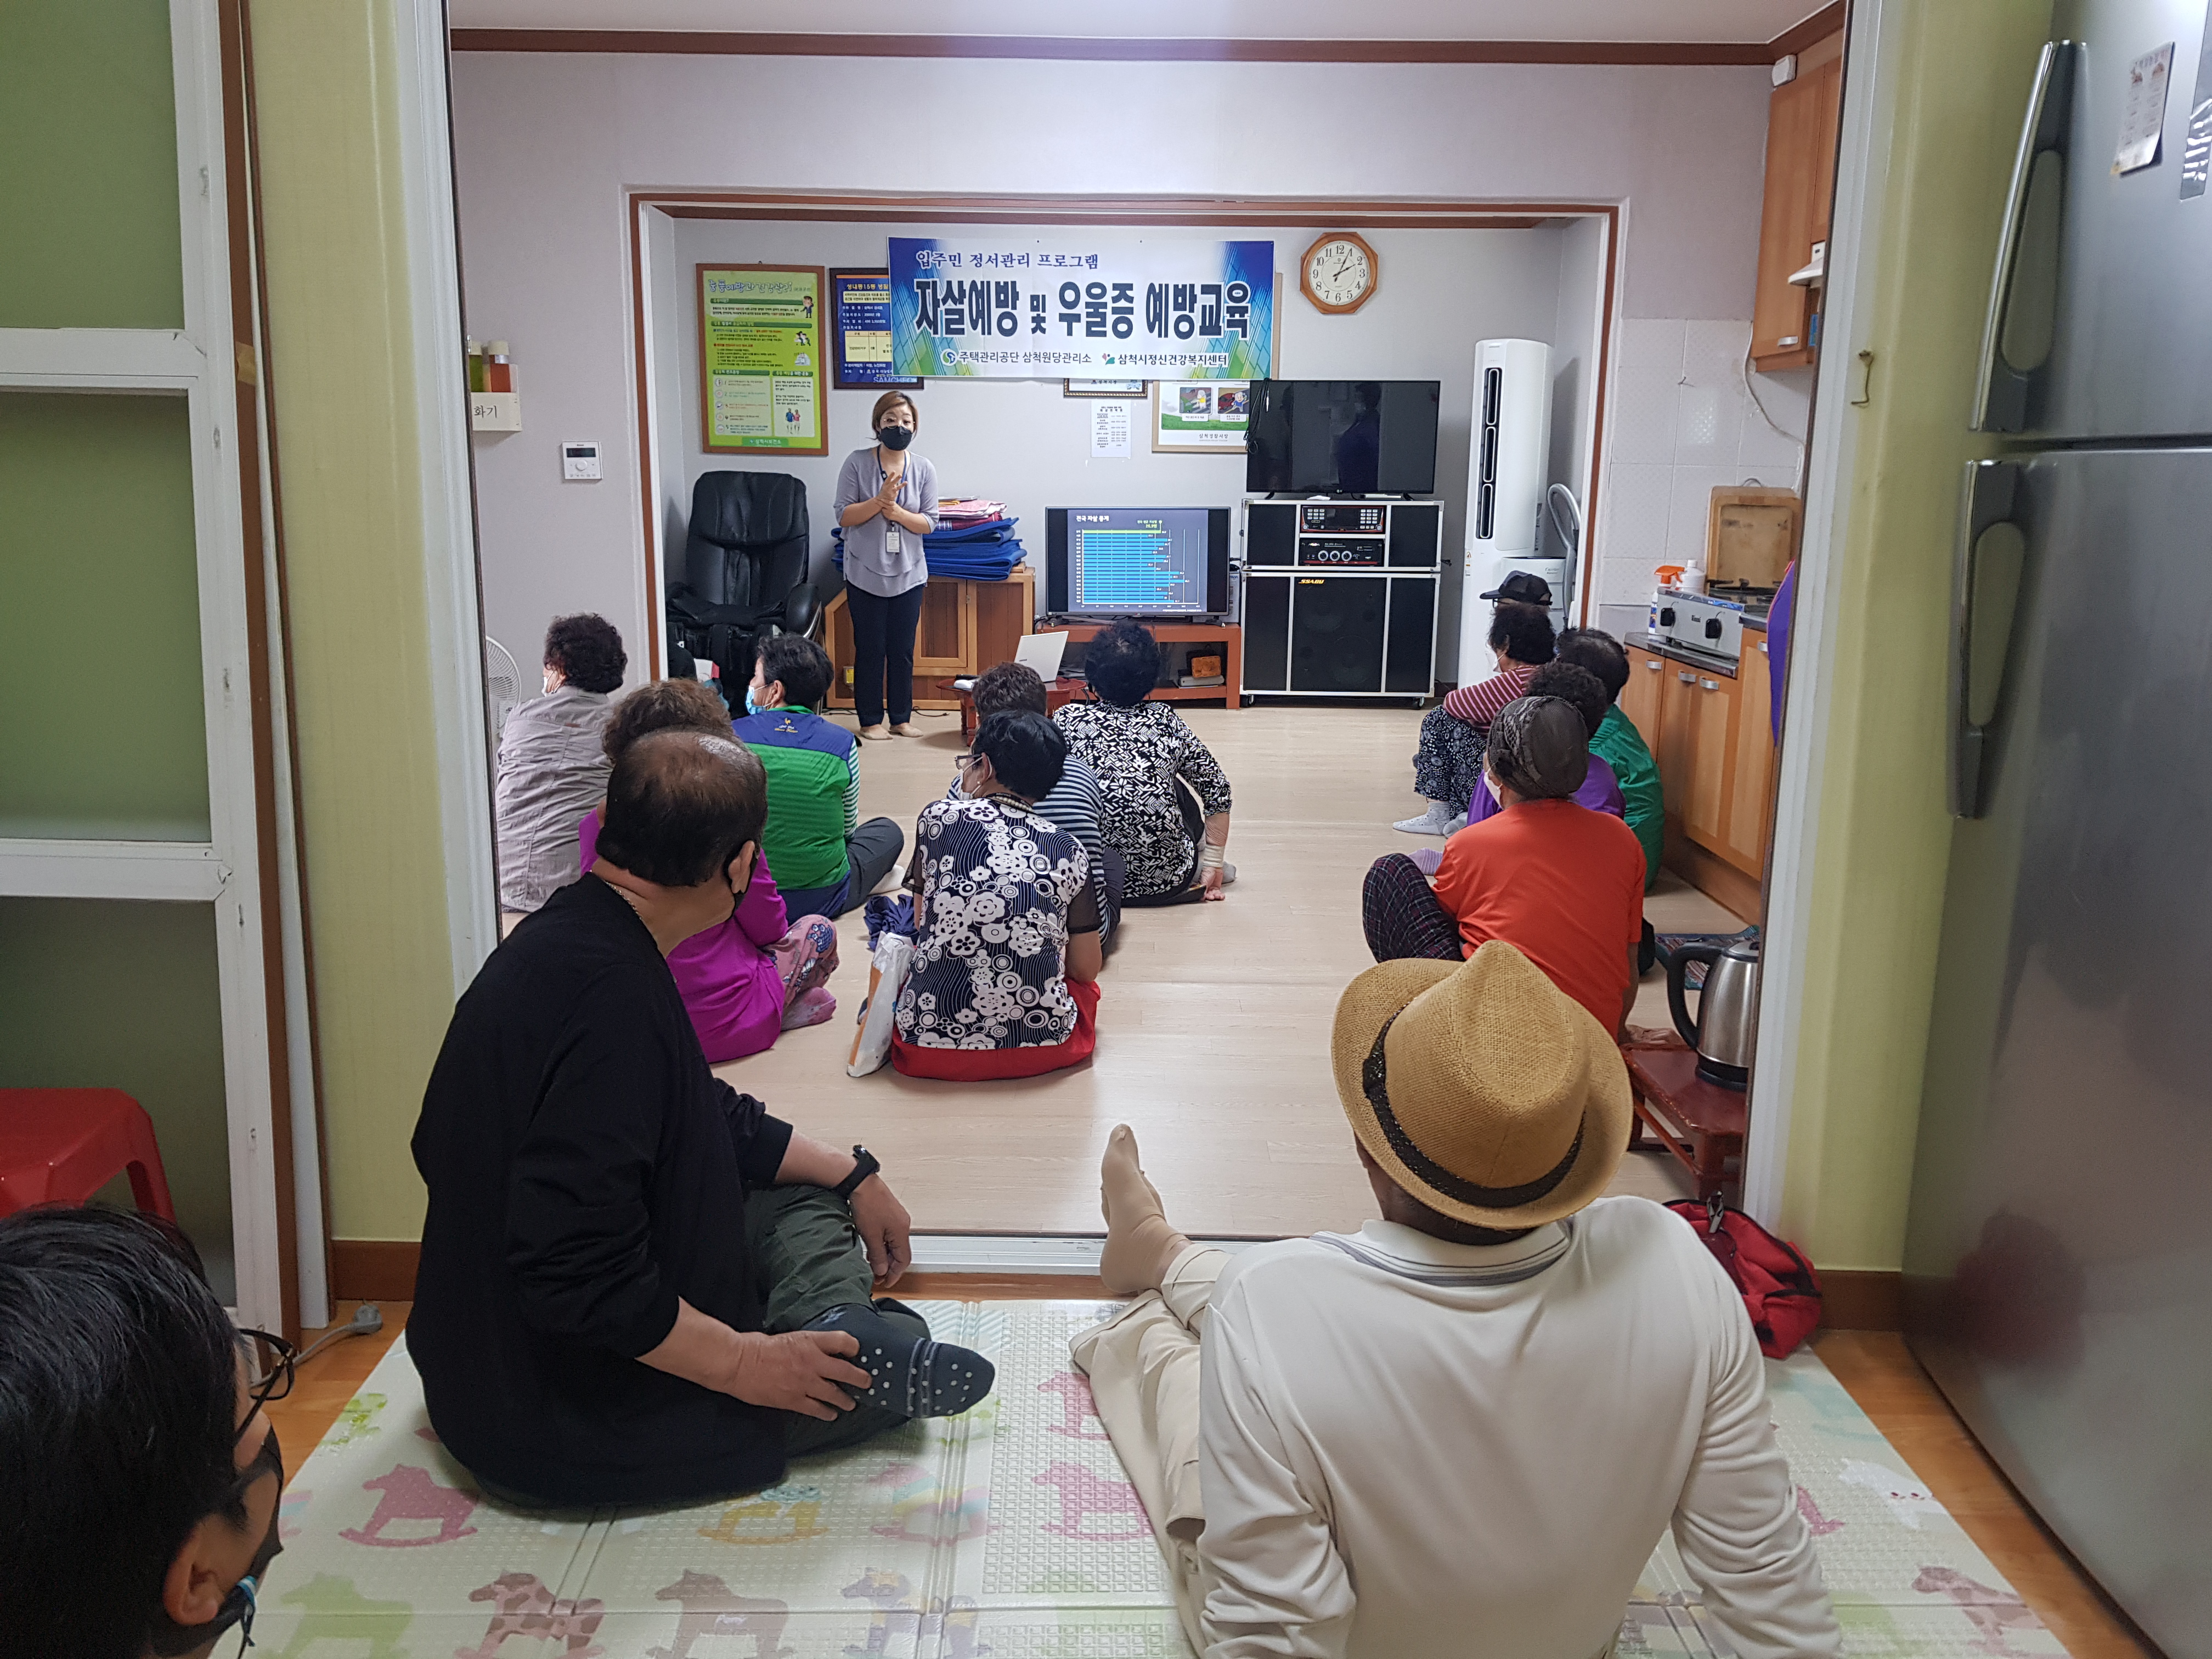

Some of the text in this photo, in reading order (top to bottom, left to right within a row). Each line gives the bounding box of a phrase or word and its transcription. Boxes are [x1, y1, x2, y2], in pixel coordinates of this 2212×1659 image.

[1325, 248, 1331, 257] 11
[1336, 245, 1344, 254] 12
[917, 252, 1098, 269] 입주민 정서관리 프로그램
[1317, 256, 1324, 266] 10
[1357, 256, 1363, 265] 2
[1313, 269, 1319, 279] 9
[1359, 268, 1365, 278] 3
[1316, 281, 1322, 291] 8
[1355, 281, 1362, 290] 4
[1324, 290, 1330, 300] 7
[1335, 292, 1341, 302] 6
[1347, 290, 1353, 300] 5
[916, 279, 1249, 340] 자살예방 및 우울증 예방교육
[959, 351, 1092, 364] 주택관리공단 삼척원당관리소
[1118, 353, 1227, 366] 삼척시정신건강복지센터
[473, 405, 497, 418] 화기
